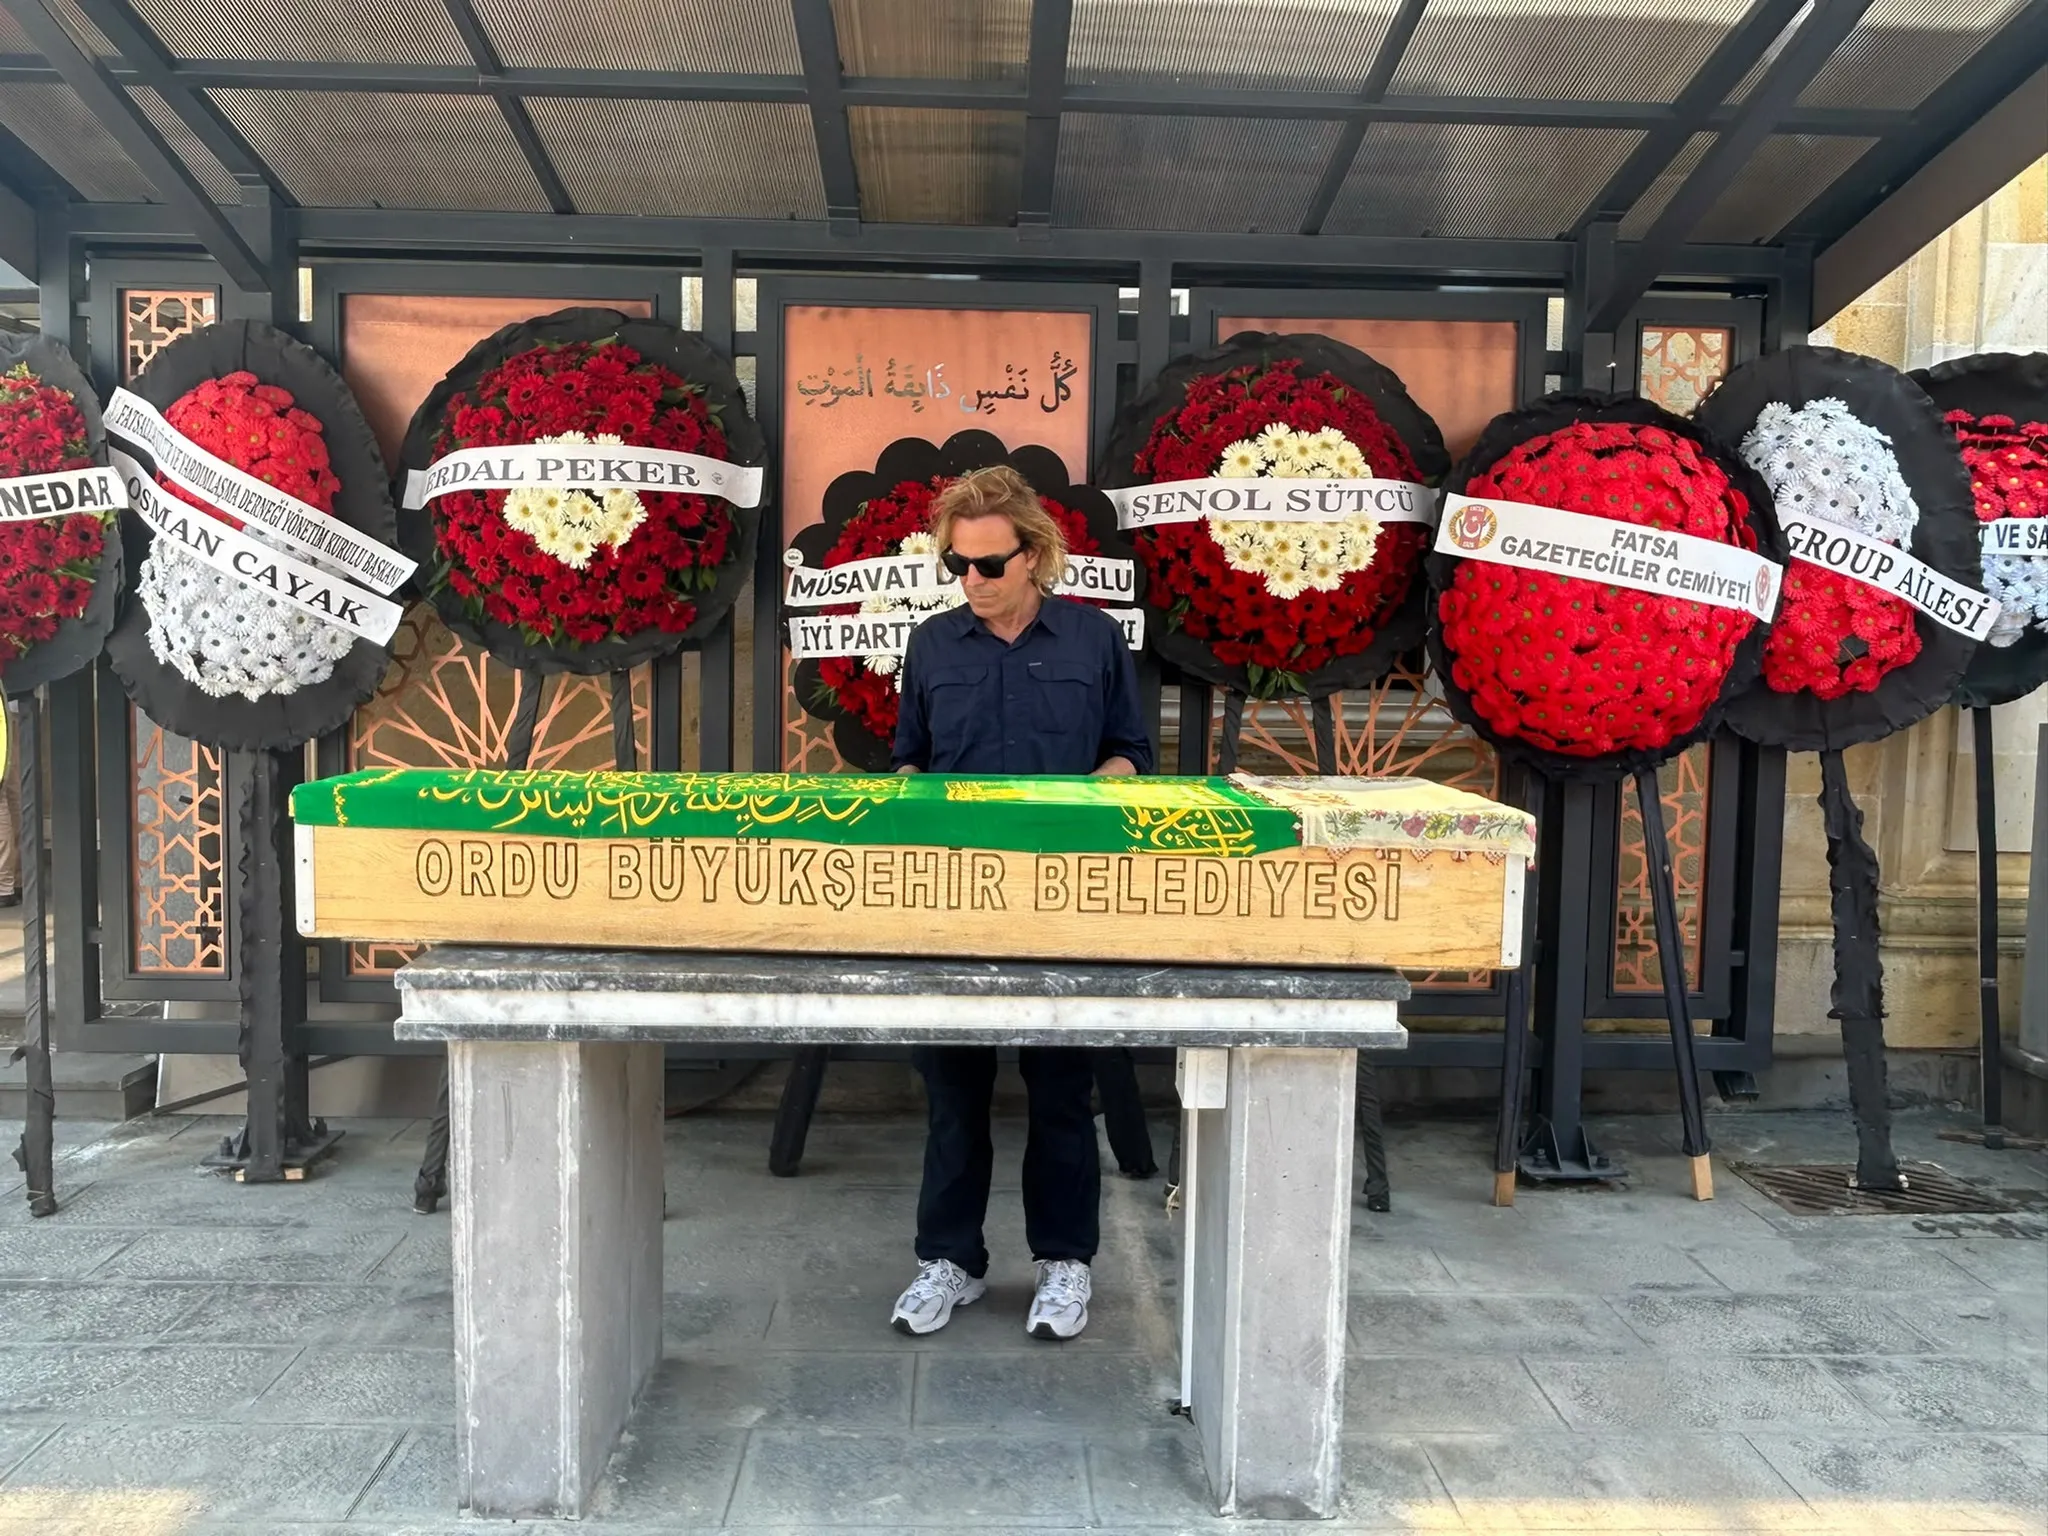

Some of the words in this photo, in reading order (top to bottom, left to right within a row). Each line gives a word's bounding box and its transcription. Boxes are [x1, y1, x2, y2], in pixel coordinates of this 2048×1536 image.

[0, 476, 114, 517] NEDAR
[425, 458, 524, 496] ERDAL
[536, 458, 700, 487] PEKER
[178, 453, 241, 504] YARDIMLAŞMA
[237, 488, 289, 528] DERNEĞİ
[281, 508, 326, 550] YÖNETİM
[324, 530, 369, 568] KURULU
[361, 555, 404, 588] BAŞKANI
[1132, 489, 1272, 523] ŞENOL
[1286, 484, 1413, 513] SÜTCÜ
[127, 476, 225, 558] OSMAN
[232, 551, 369, 628] CAYAK
[1611, 529, 1679, 561] FATSA
[1995, 524, 2020, 548] VE
[790, 563, 925, 599] MÜSAVAT
[1500, 535, 1660, 584] GAZETECİLER
[1666, 566, 1751, 604] CEMİYETİ
[1784, 521, 1894, 582] GROUP
[1895, 566, 1991, 632] AİLESİ
[800, 619, 833, 651] İYİ
[416, 838, 578, 899] ORDU
[608, 836, 1007, 912] BÜYÜKŞEHİR
[1034, 847, 1402, 922] BELEDİYESİ
